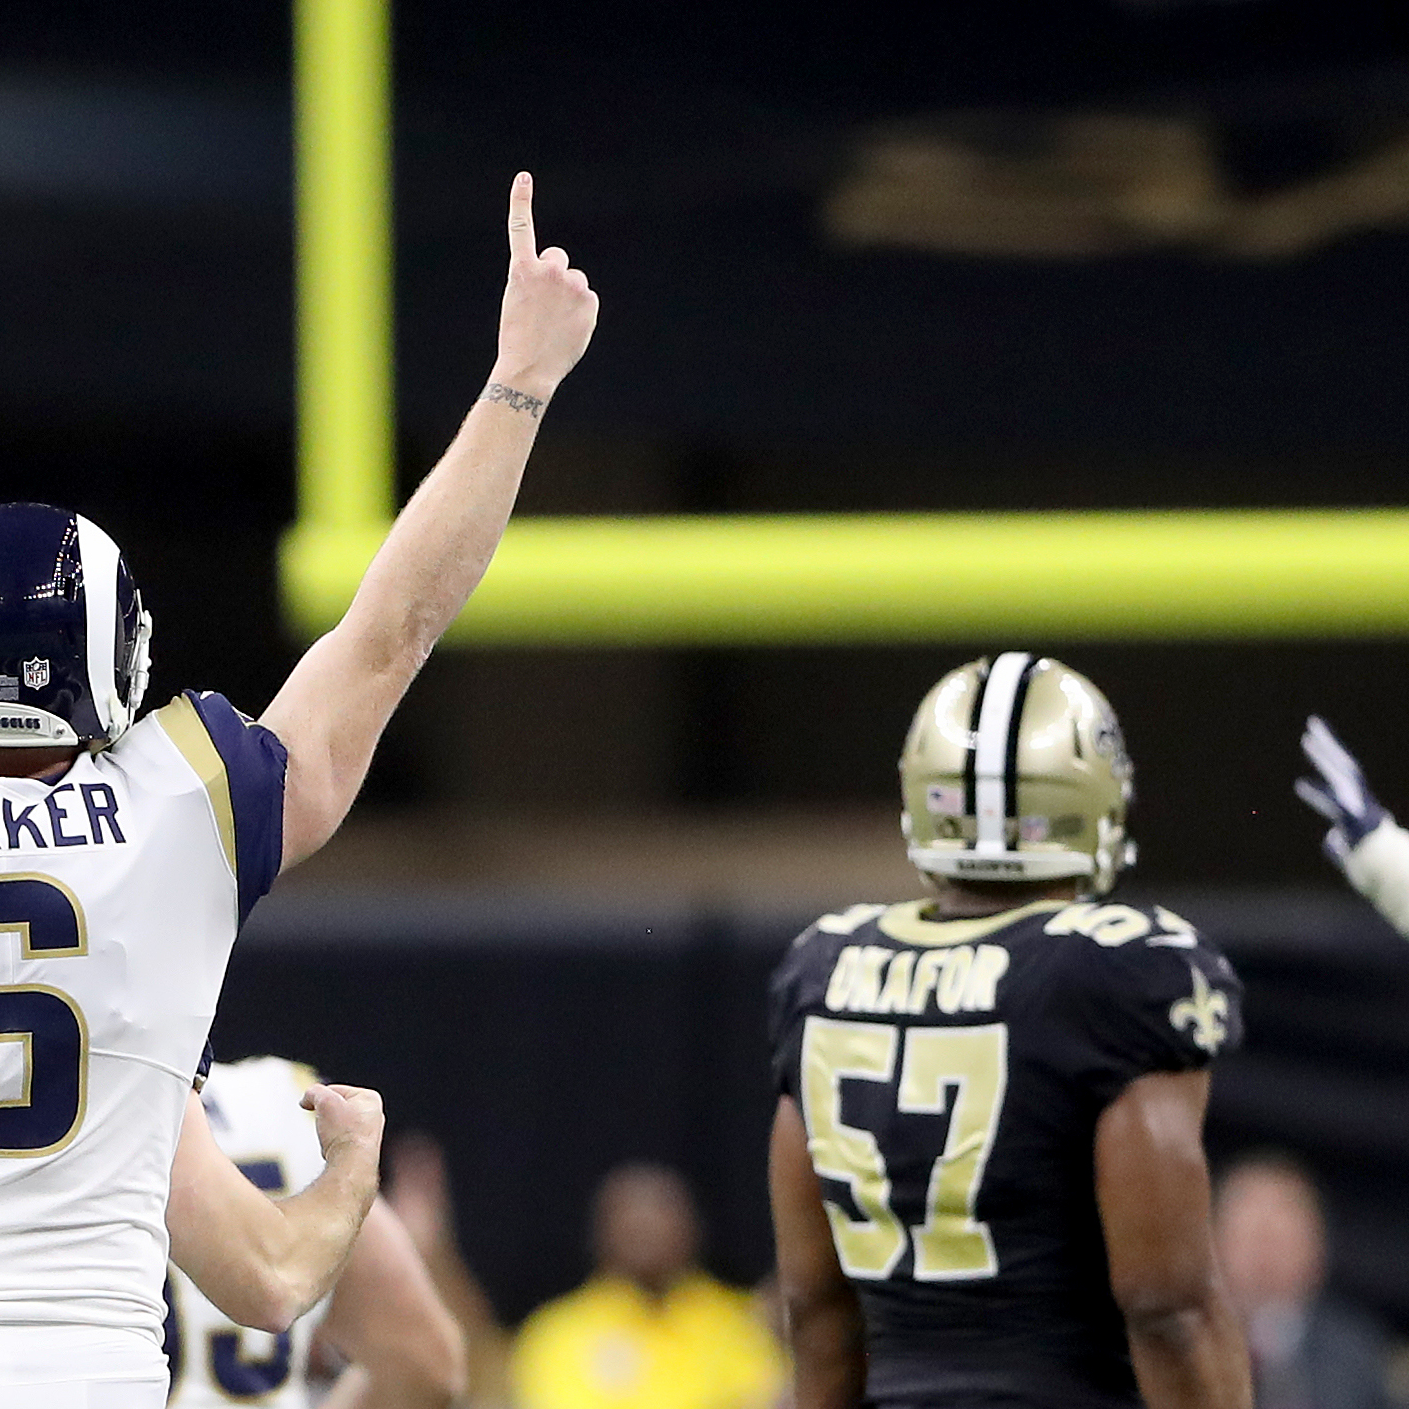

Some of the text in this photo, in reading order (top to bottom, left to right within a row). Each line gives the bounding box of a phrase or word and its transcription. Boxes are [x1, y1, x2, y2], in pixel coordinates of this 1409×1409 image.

[27, 670, 47, 684] NFL
[824, 944, 1010, 1015] OKAFOR
[799, 1016, 1009, 1282] 57
